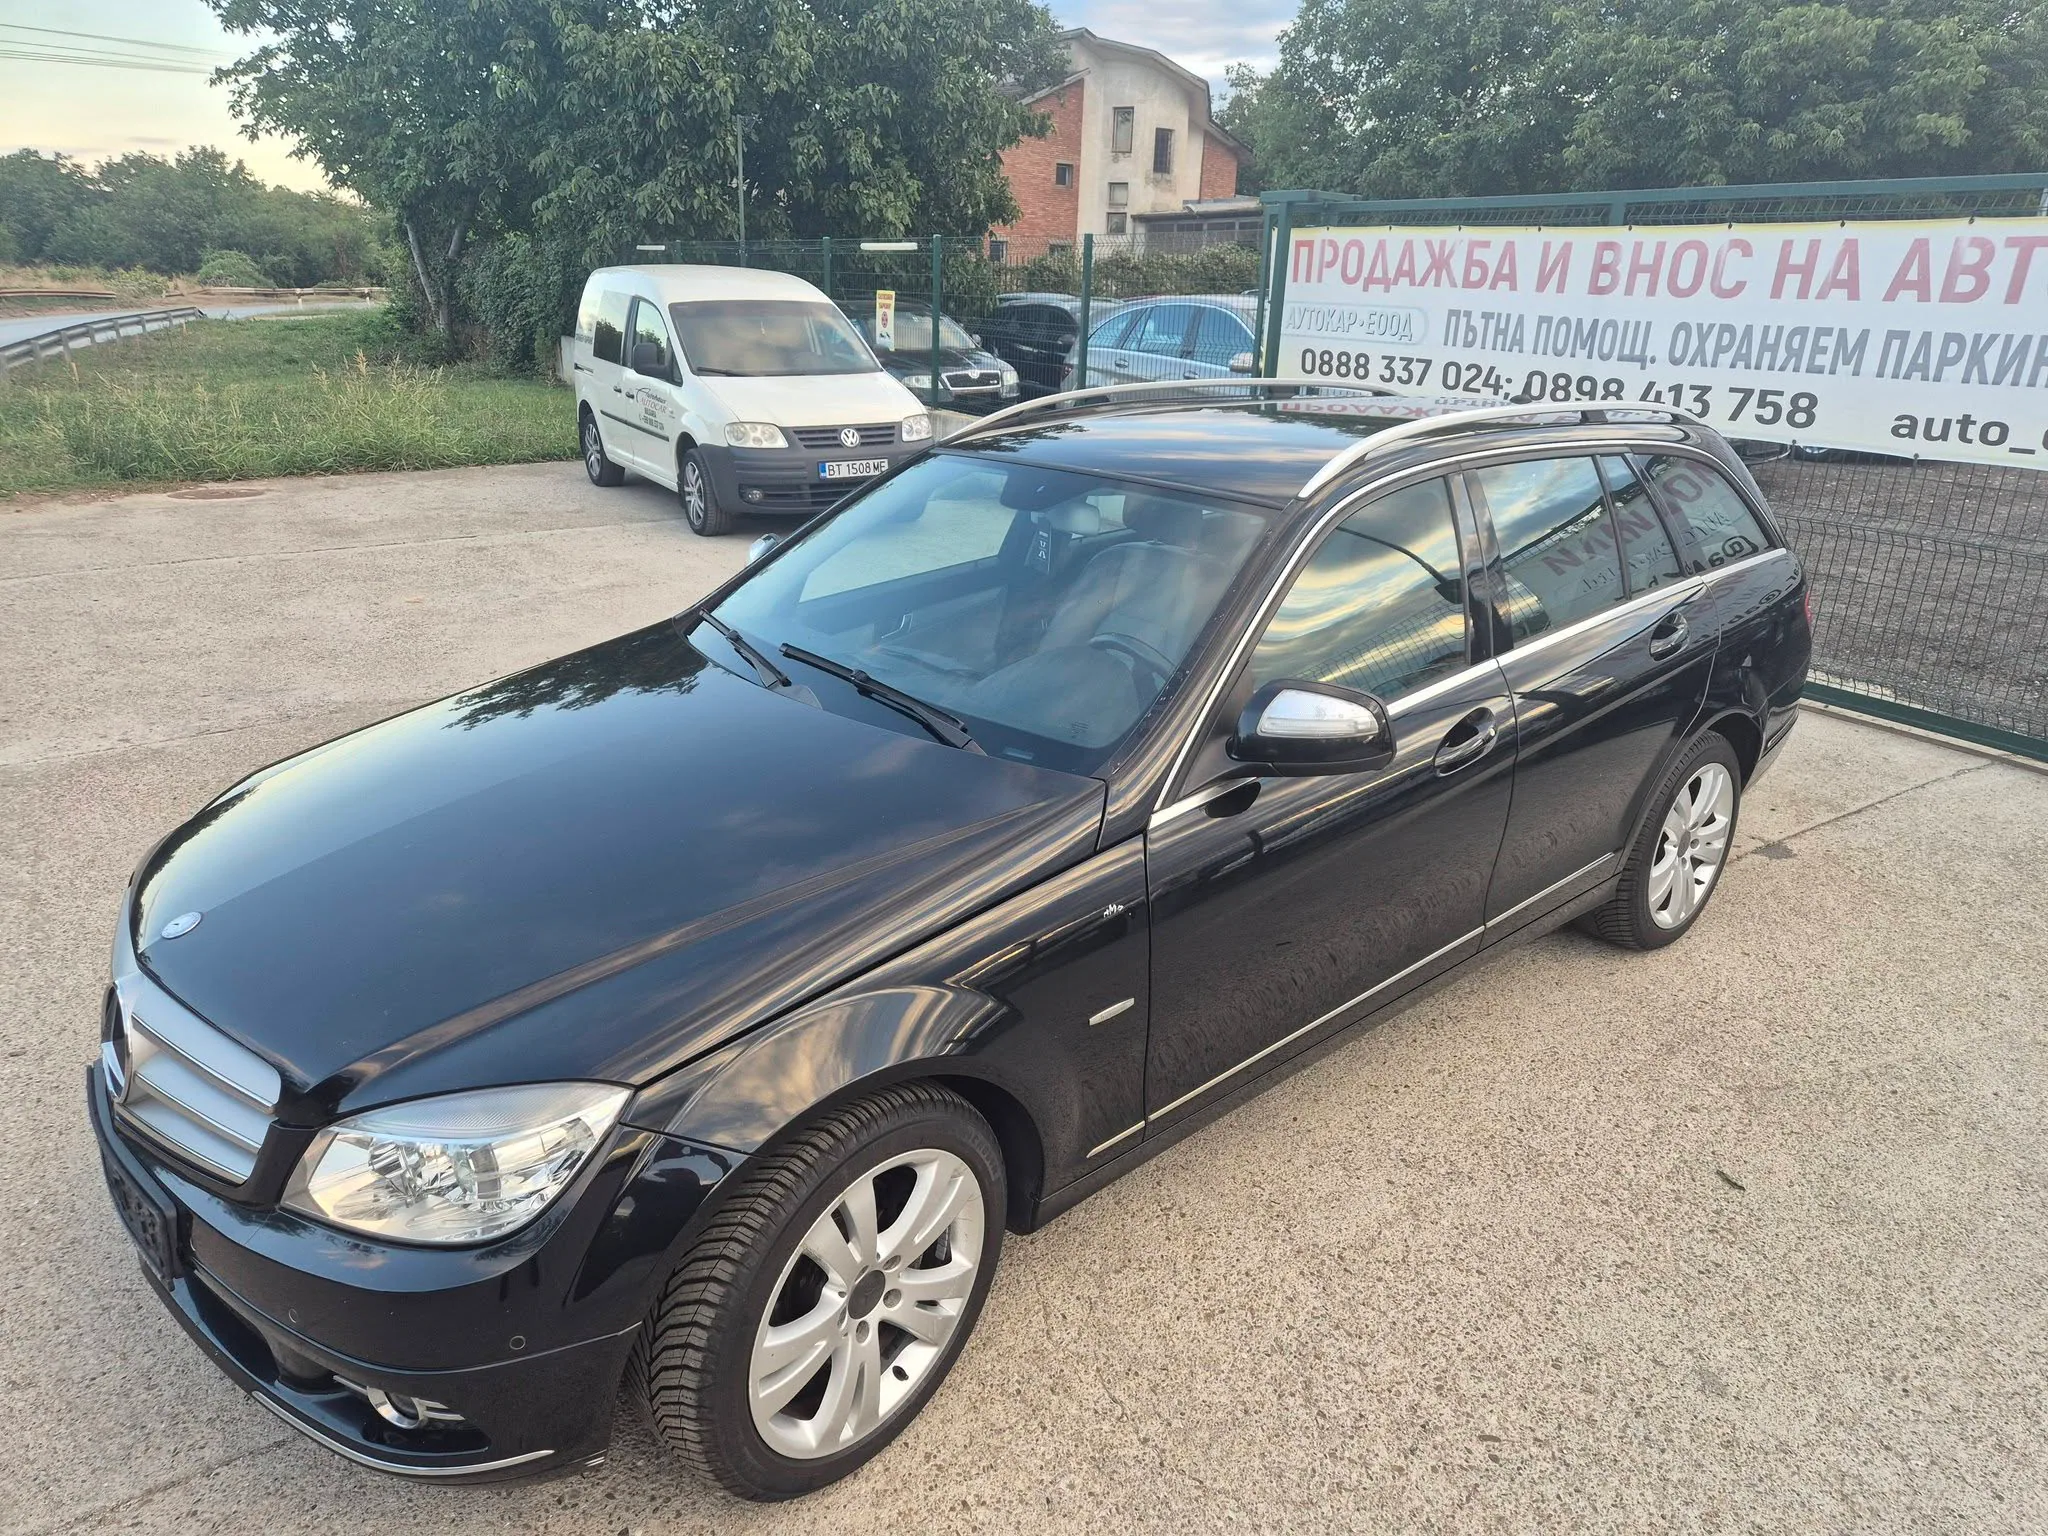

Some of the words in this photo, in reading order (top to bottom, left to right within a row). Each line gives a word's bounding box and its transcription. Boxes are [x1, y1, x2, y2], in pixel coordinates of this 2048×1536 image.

[1292, 238, 1518, 293] ПРОДАЖБА
[1534, 240, 1574, 294] И
[1587, 238, 1754, 299] ВНОС
[1769, 238, 1861, 301] НА
[1443, 308, 1526, 354] ПЪТНА
[1531, 315, 1657, 371] ПОМОЩ.
[1667, 320, 1871, 377] ОХРАНЯЕМ
[1301, 347, 1370, 380] 0888
[1378, 354, 1433, 387] 337
[1441, 361, 1513, 400] 024;
[1526, 370, 1626, 401] 0898
[1638, 380, 1714, 419] 413
[1727, 386, 1819, 429] 758
[1890, 413, 2048, 456] auto_
[827, 464, 843, 476] BT
[846, 462, 871, 475] 1508
